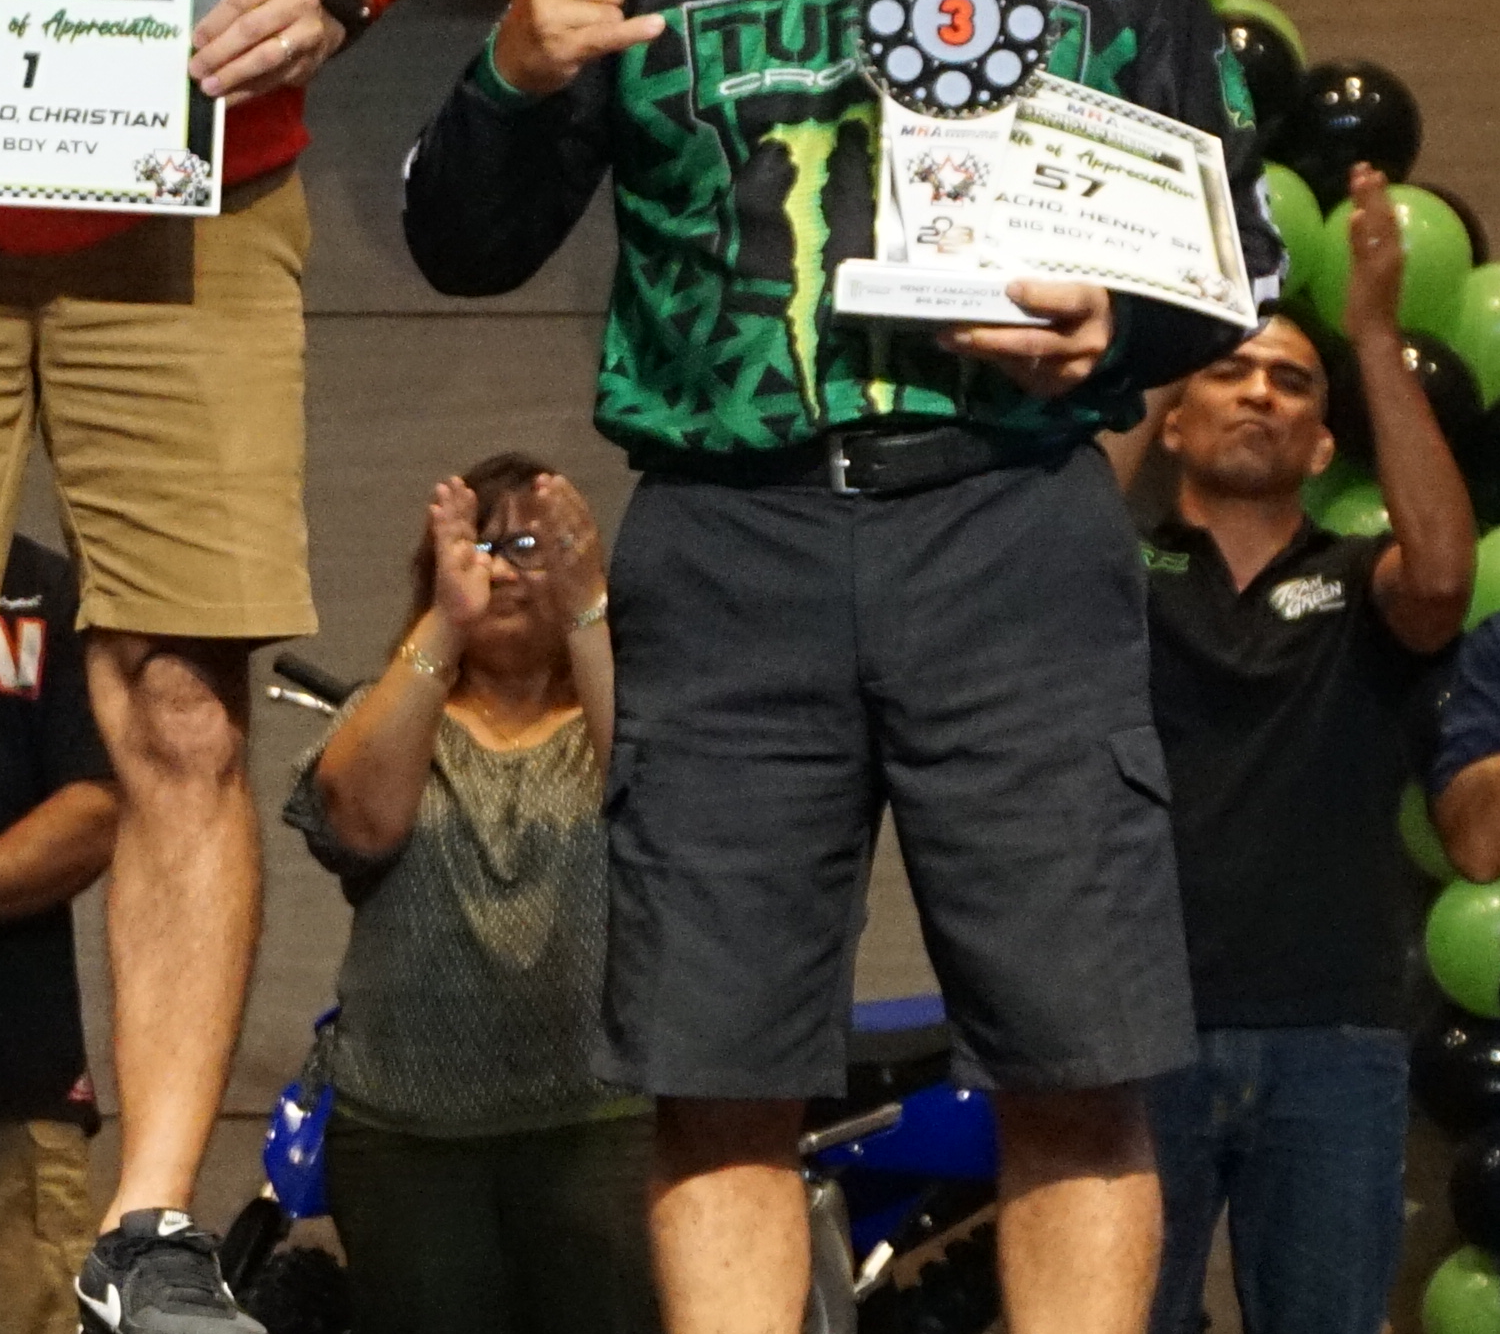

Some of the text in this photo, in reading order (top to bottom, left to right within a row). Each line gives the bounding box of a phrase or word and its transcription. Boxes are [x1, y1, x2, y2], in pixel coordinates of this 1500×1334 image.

[8, 12, 30, 39] of
[42, 7, 182, 44] Appreciation
[22, 51, 41, 89] 1
[28, 106, 170, 128] CHRISTIAN
[901, 125, 942, 137] MRA
[1067, 103, 1119, 129] MRA
[3, 137, 48, 154] BOY
[56, 140, 99, 155] ATV
[1033, 163, 1108, 198] 57
[1008, 218, 1142, 253] BIG BOY ATV
[1080, 208, 1160, 239] HENRY
